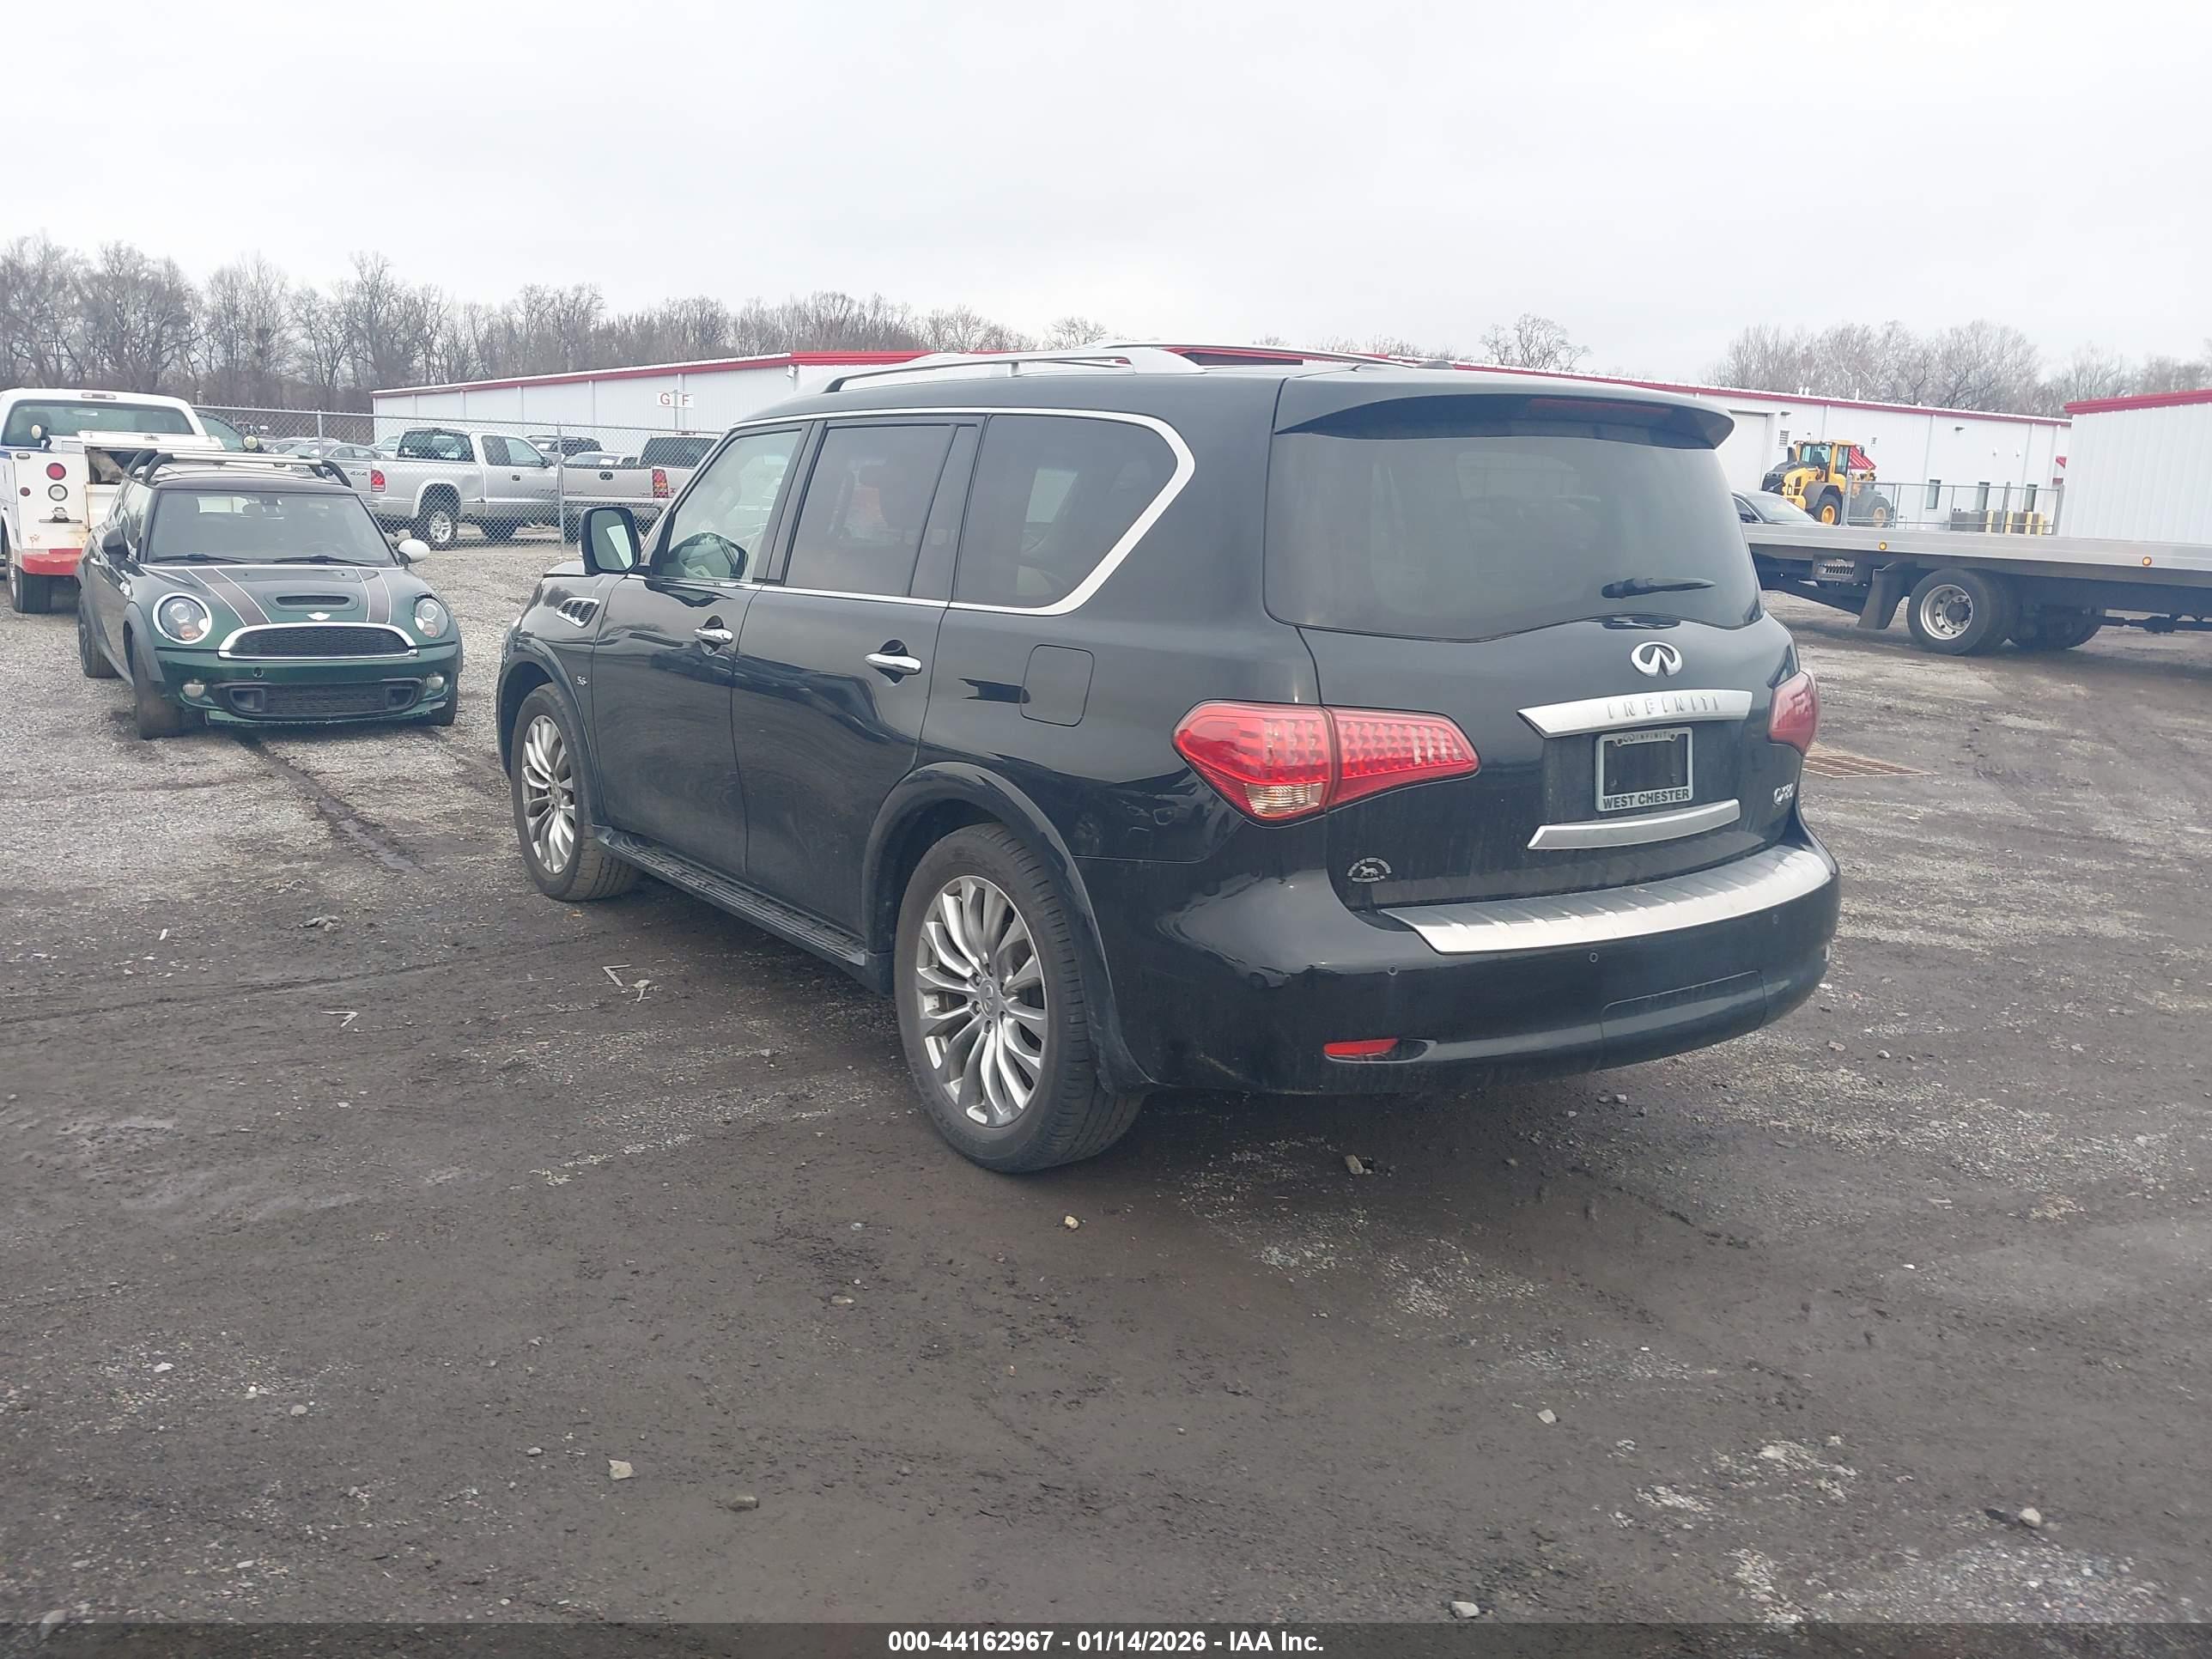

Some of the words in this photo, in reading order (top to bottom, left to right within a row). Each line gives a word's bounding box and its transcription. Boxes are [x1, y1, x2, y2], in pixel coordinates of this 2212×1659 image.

[659, 392, 671, 405] G
[682, 394, 690, 406] F
[1607, 696, 1718, 719] INFINITI
[1602, 794, 1636, 810] WEST
[1638, 788, 1690, 805] CHESTER
